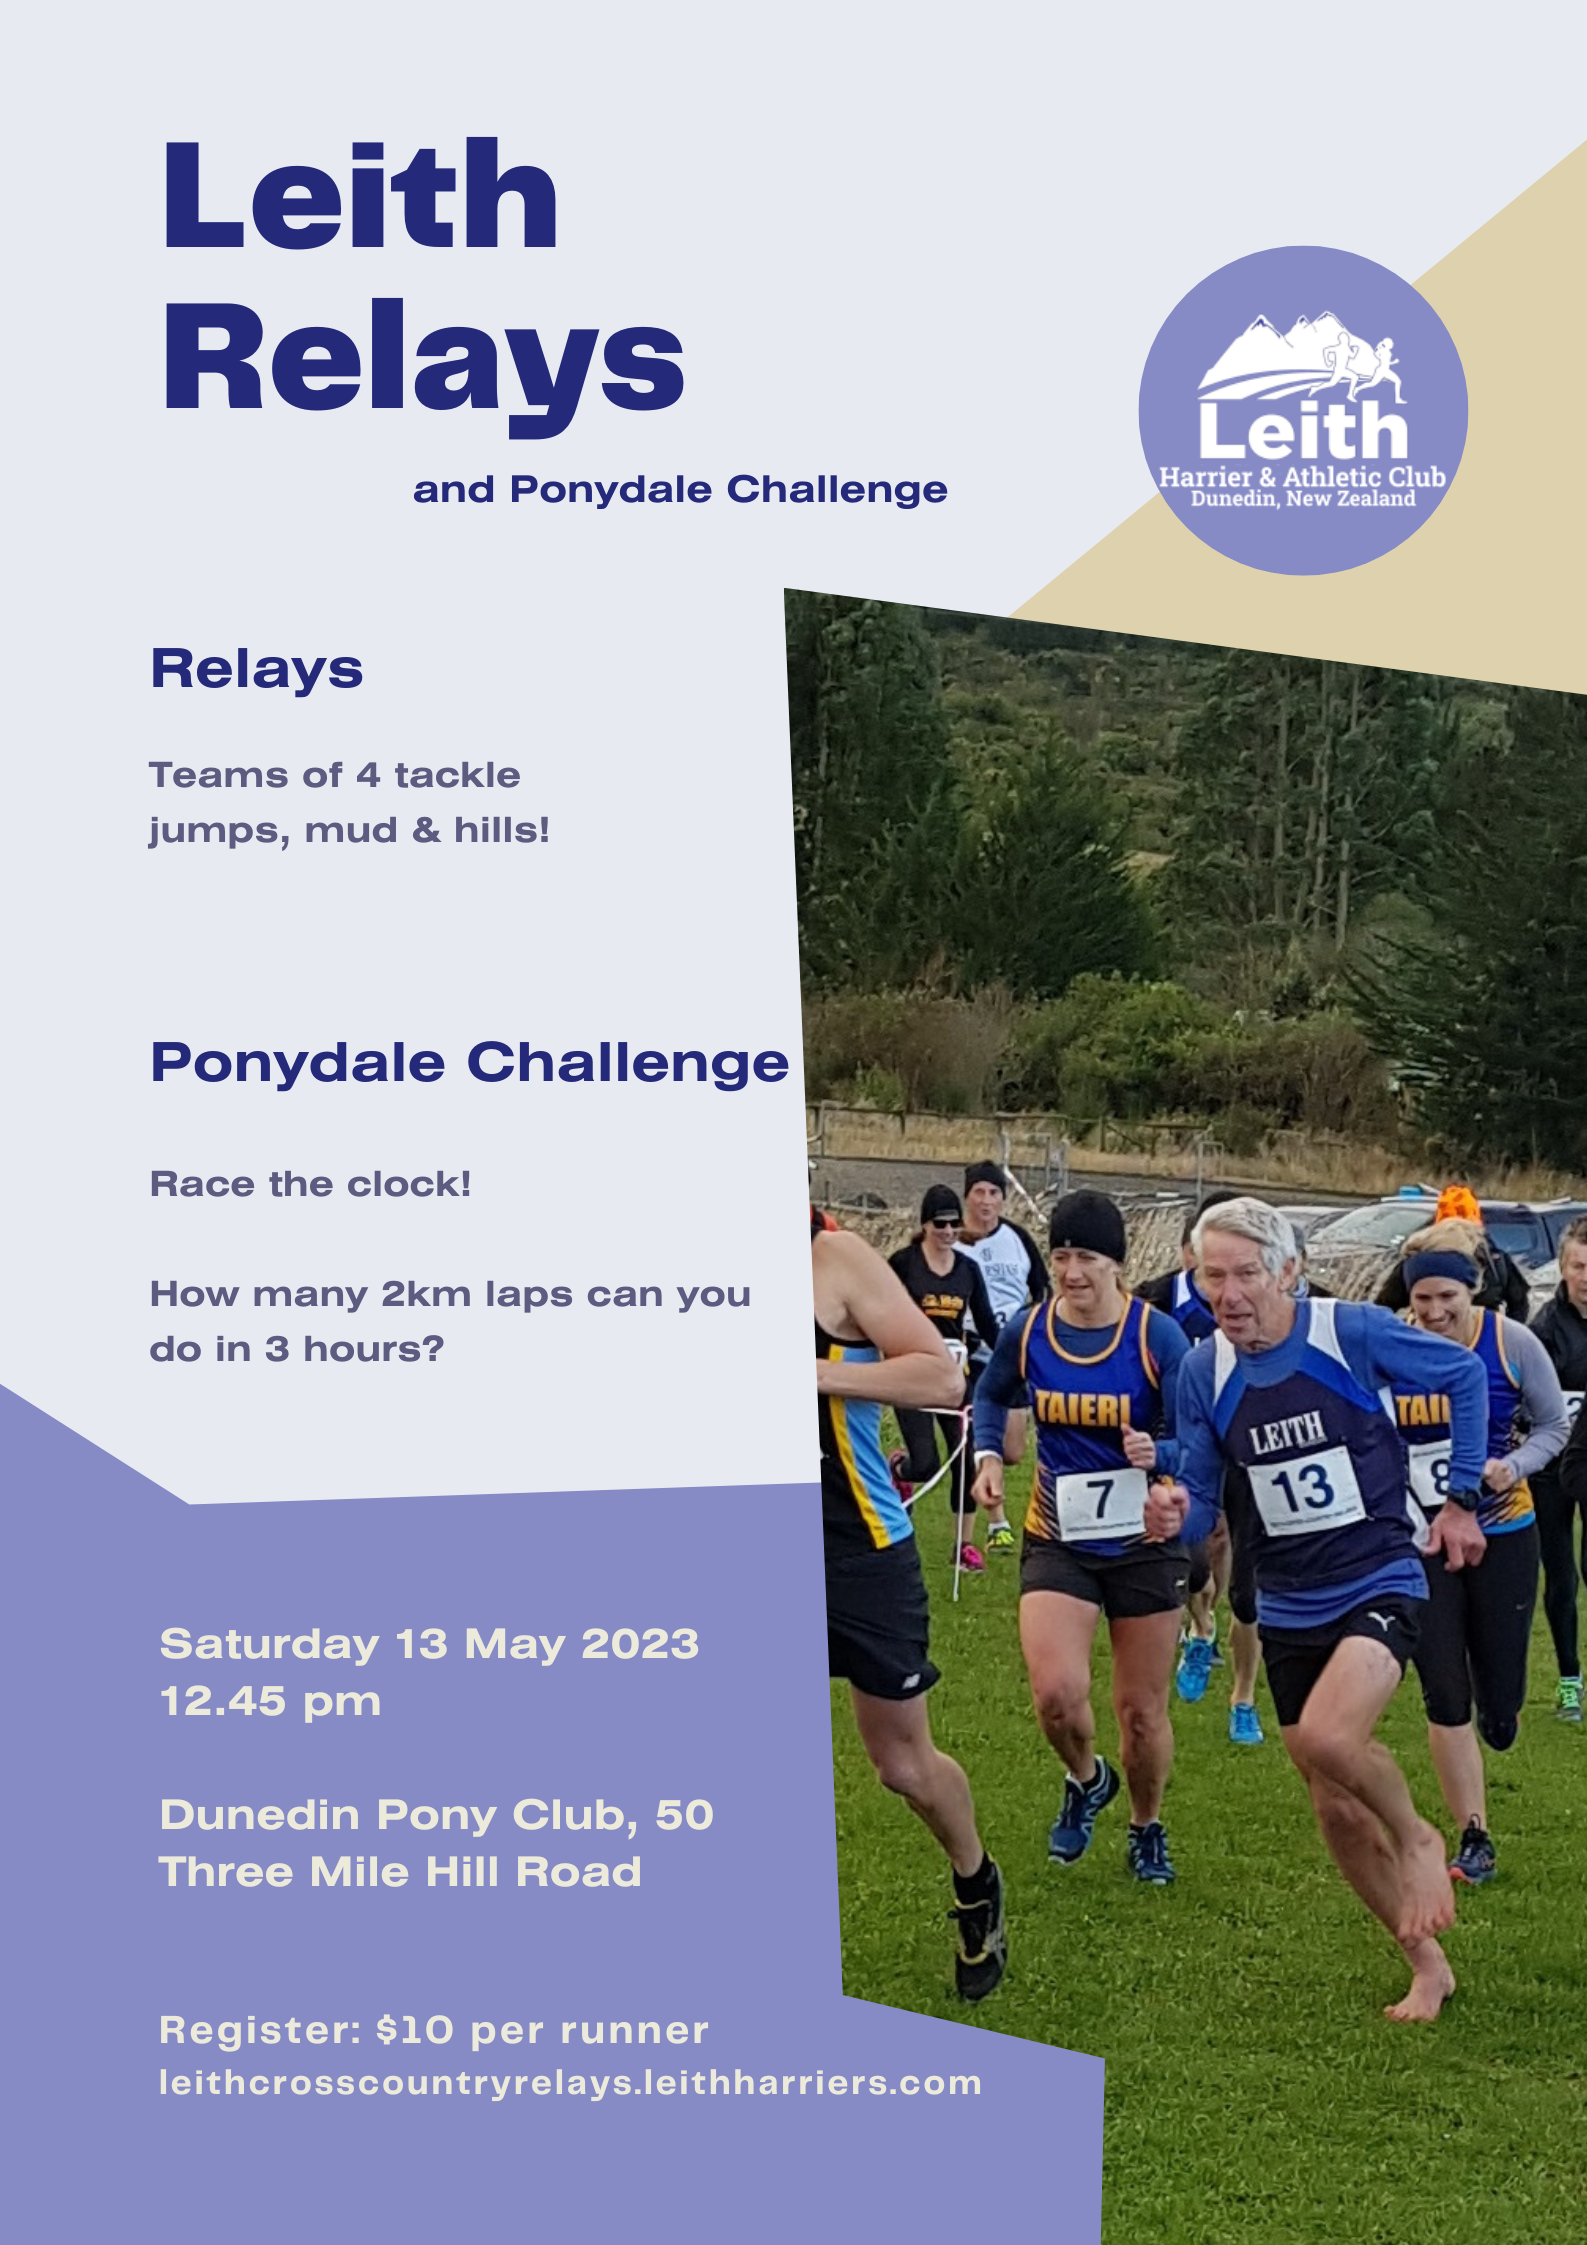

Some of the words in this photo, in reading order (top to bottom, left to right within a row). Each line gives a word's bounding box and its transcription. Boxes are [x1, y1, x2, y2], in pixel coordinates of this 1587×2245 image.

[166, 137, 556, 250] Leith
[166, 298, 684, 440] Relays
[1200, 400, 1408, 460] Leith
[414, 475, 493, 503] and
[512, 475, 712, 509] Ponydale
[727, 474, 948, 509] Challenge
[1160, 466, 1252, 487] Harrier
[1259, 467, 1276, 487] &
[1283, 466, 1381, 487] Athletic
[1389, 466, 1446, 487] Club
[1191, 490, 1280, 510] Dunedin,
[1286, 490, 1332, 506] New
[1337, 490, 1416, 506] Zealand
[153, 648, 363, 698] Relays
[148, 761, 288, 788] Teams
[303, 761, 343, 788] of
[357, 762, 380, 787] 4
[395, 761, 520, 788] tackle
[148, 816, 289, 851] jumps,
[306, 816, 396, 843] mud
[413, 816, 442, 843] &
[456, 816, 548, 843] hills!
[153, 1042, 445, 1092] Ponydale
[468, 1041, 789, 1092] Challenge
[151, 1170, 254, 1197] Race
[269, 1170, 333, 1197] the
[348, 1170, 469, 1197] clock!
[151, 1280, 240, 1307] How
[254, 1286, 368, 1313] many
[382, 1280, 470, 1306] 2km
[487, 1280, 572, 1313] laps
[587, 1286, 662, 1307] can
[676, 1286, 750, 1313] you
[150, 1335, 201, 1362] do
[217, 1335, 250, 1361] in
[266, 1335, 289, 1362] 3
[305, 1335, 444, 1362] hours?
[1035, 1389, 1131, 1427] TAIERI
[1250, 1410, 1326, 1455] LEITH
[1271, 1464, 1334, 1513] 13
[1431, 1459, 1450, 1496] 8
[1087, 1479, 1114, 1519] 7
[161, 1627, 380, 1666] Saturday
[397, 1628, 447, 1659] 13
[467, 1628, 566, 1666] May
[582, 1628, 698, 1659] 2023
[161, 1685, 285, 1716] 12.45
[305, 1692, 380, 1723] pm
[162, 1799, 358, 1830] Dunedin
[379, 1799, 497, 1837] Pony
[513, 1798, 636, 1839] Club,
[656, 1799, 713, 1830] 50
[158, 1856, 293, 1887] Three
[312, 1856, 408, 1887] Mile
[428, 1856, 497, 1886] Hill
[518, 1856, 640, 1887] Road
[161, 2016, 359, 2052] Register:
[377, 2014, 453, 2045] $10
[472, 2022, 543, 2051] per
[562, 2022, 708, 2044] runner
[161, 2069, 980, 2101] leithcrosscountryrelays.leithharriers.com
